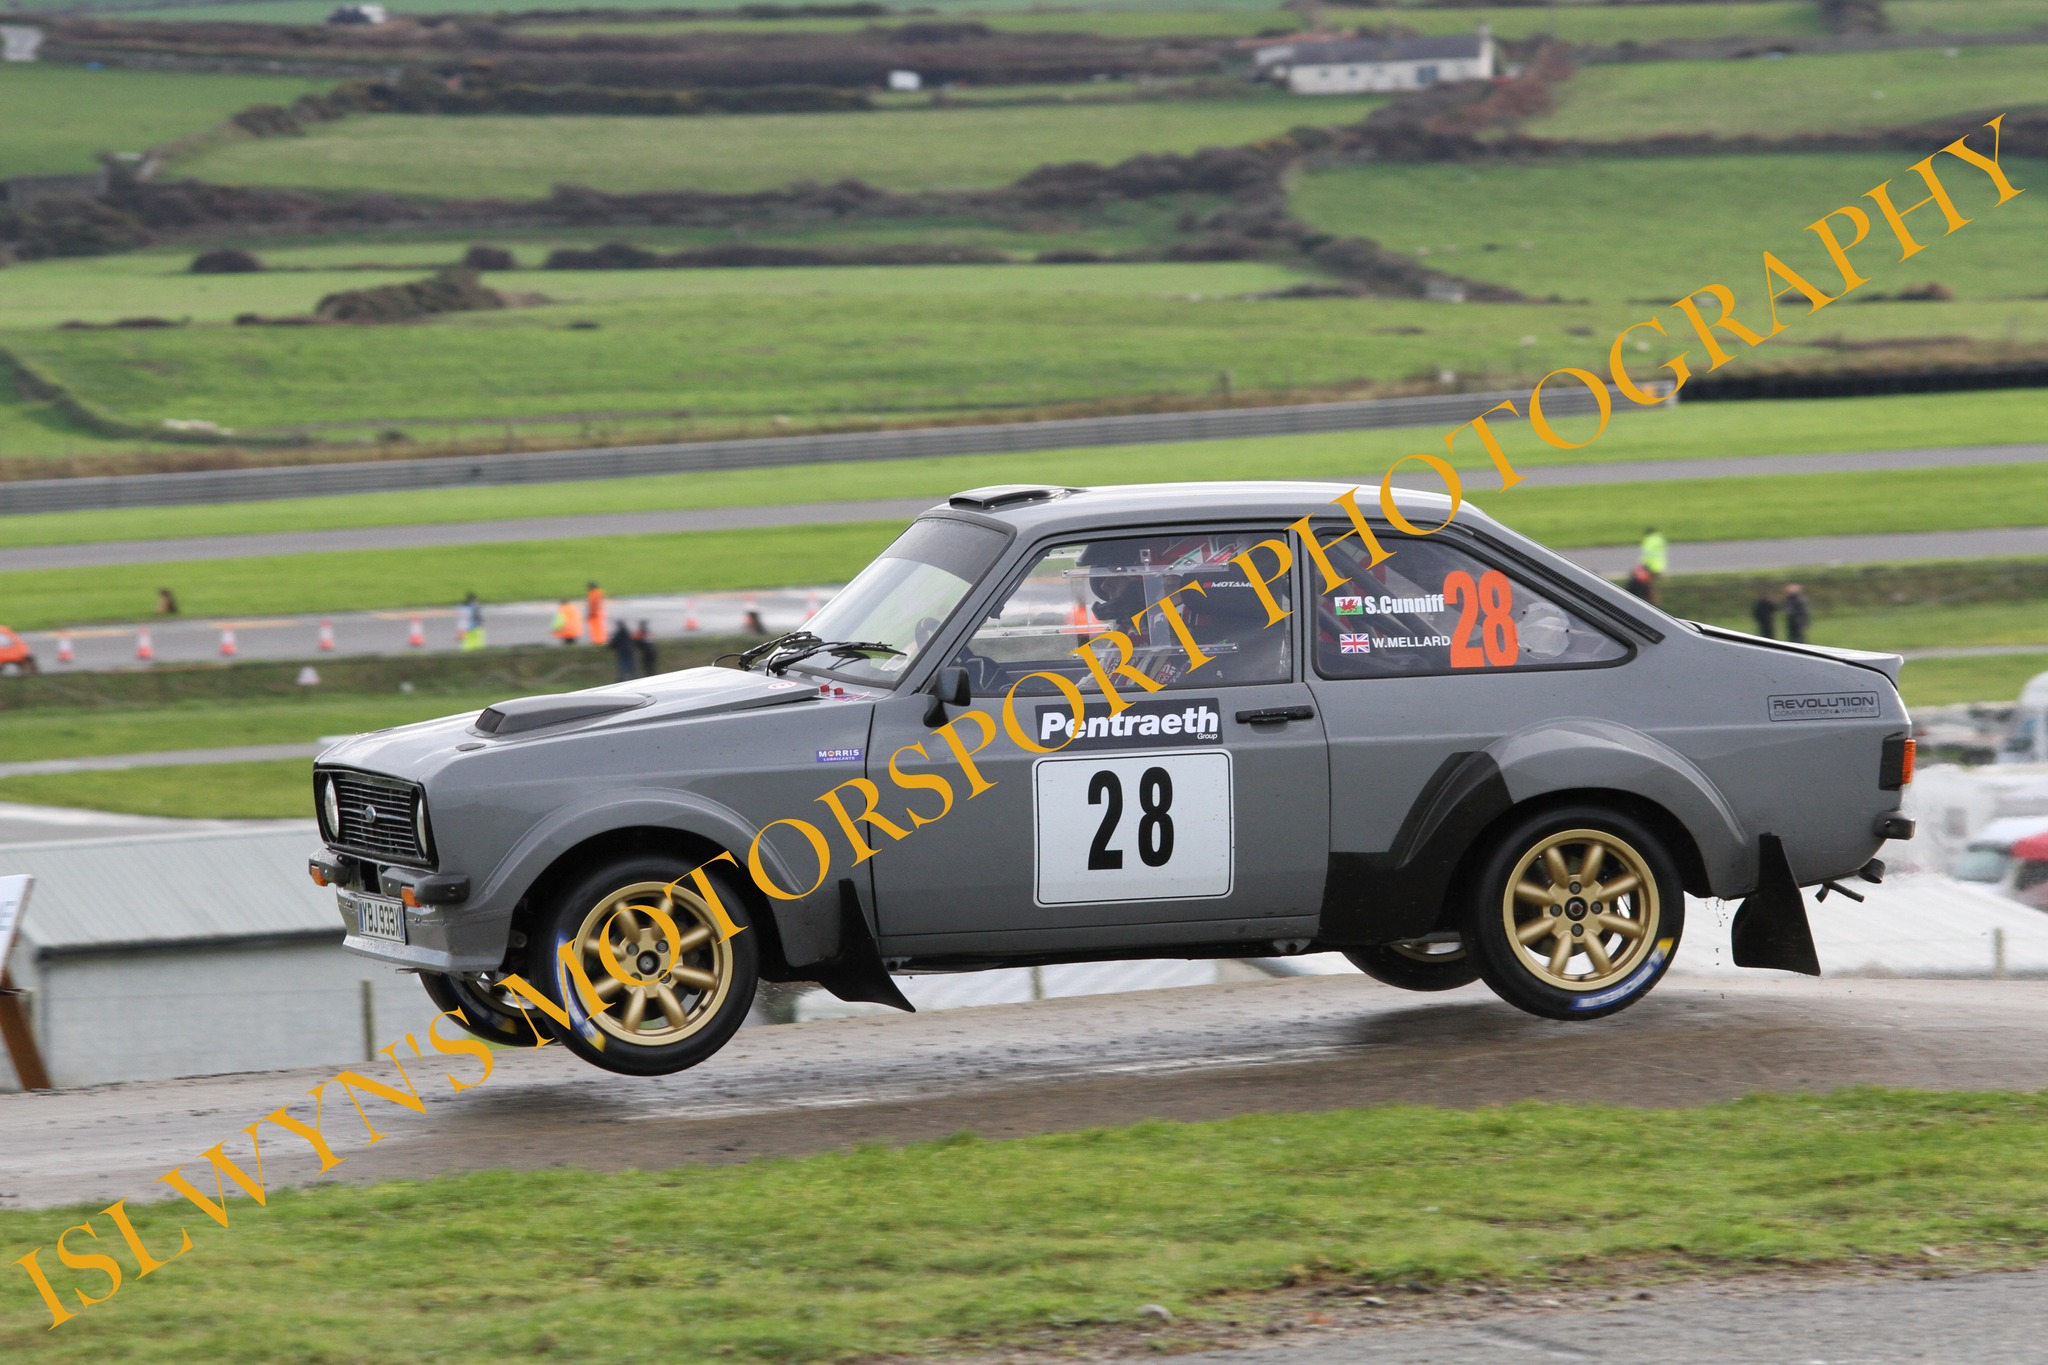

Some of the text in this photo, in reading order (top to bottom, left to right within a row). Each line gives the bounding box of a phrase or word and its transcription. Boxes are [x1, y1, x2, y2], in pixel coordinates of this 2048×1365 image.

[1364, 594, 1445, 615] S.Cunniff
[1443, 569, 1519, 668] 28
[1372, 635, 1451, 648] W.MELLARD
[1773, 696, 1874, 709] REVOLUTION
[1041, 706, 1219, 740] Pentraeth
[1196, 732, 1218, 740] Group
[818, 749, 860, 757] MORRIS
[1088, 766, 1174, 871] 28
